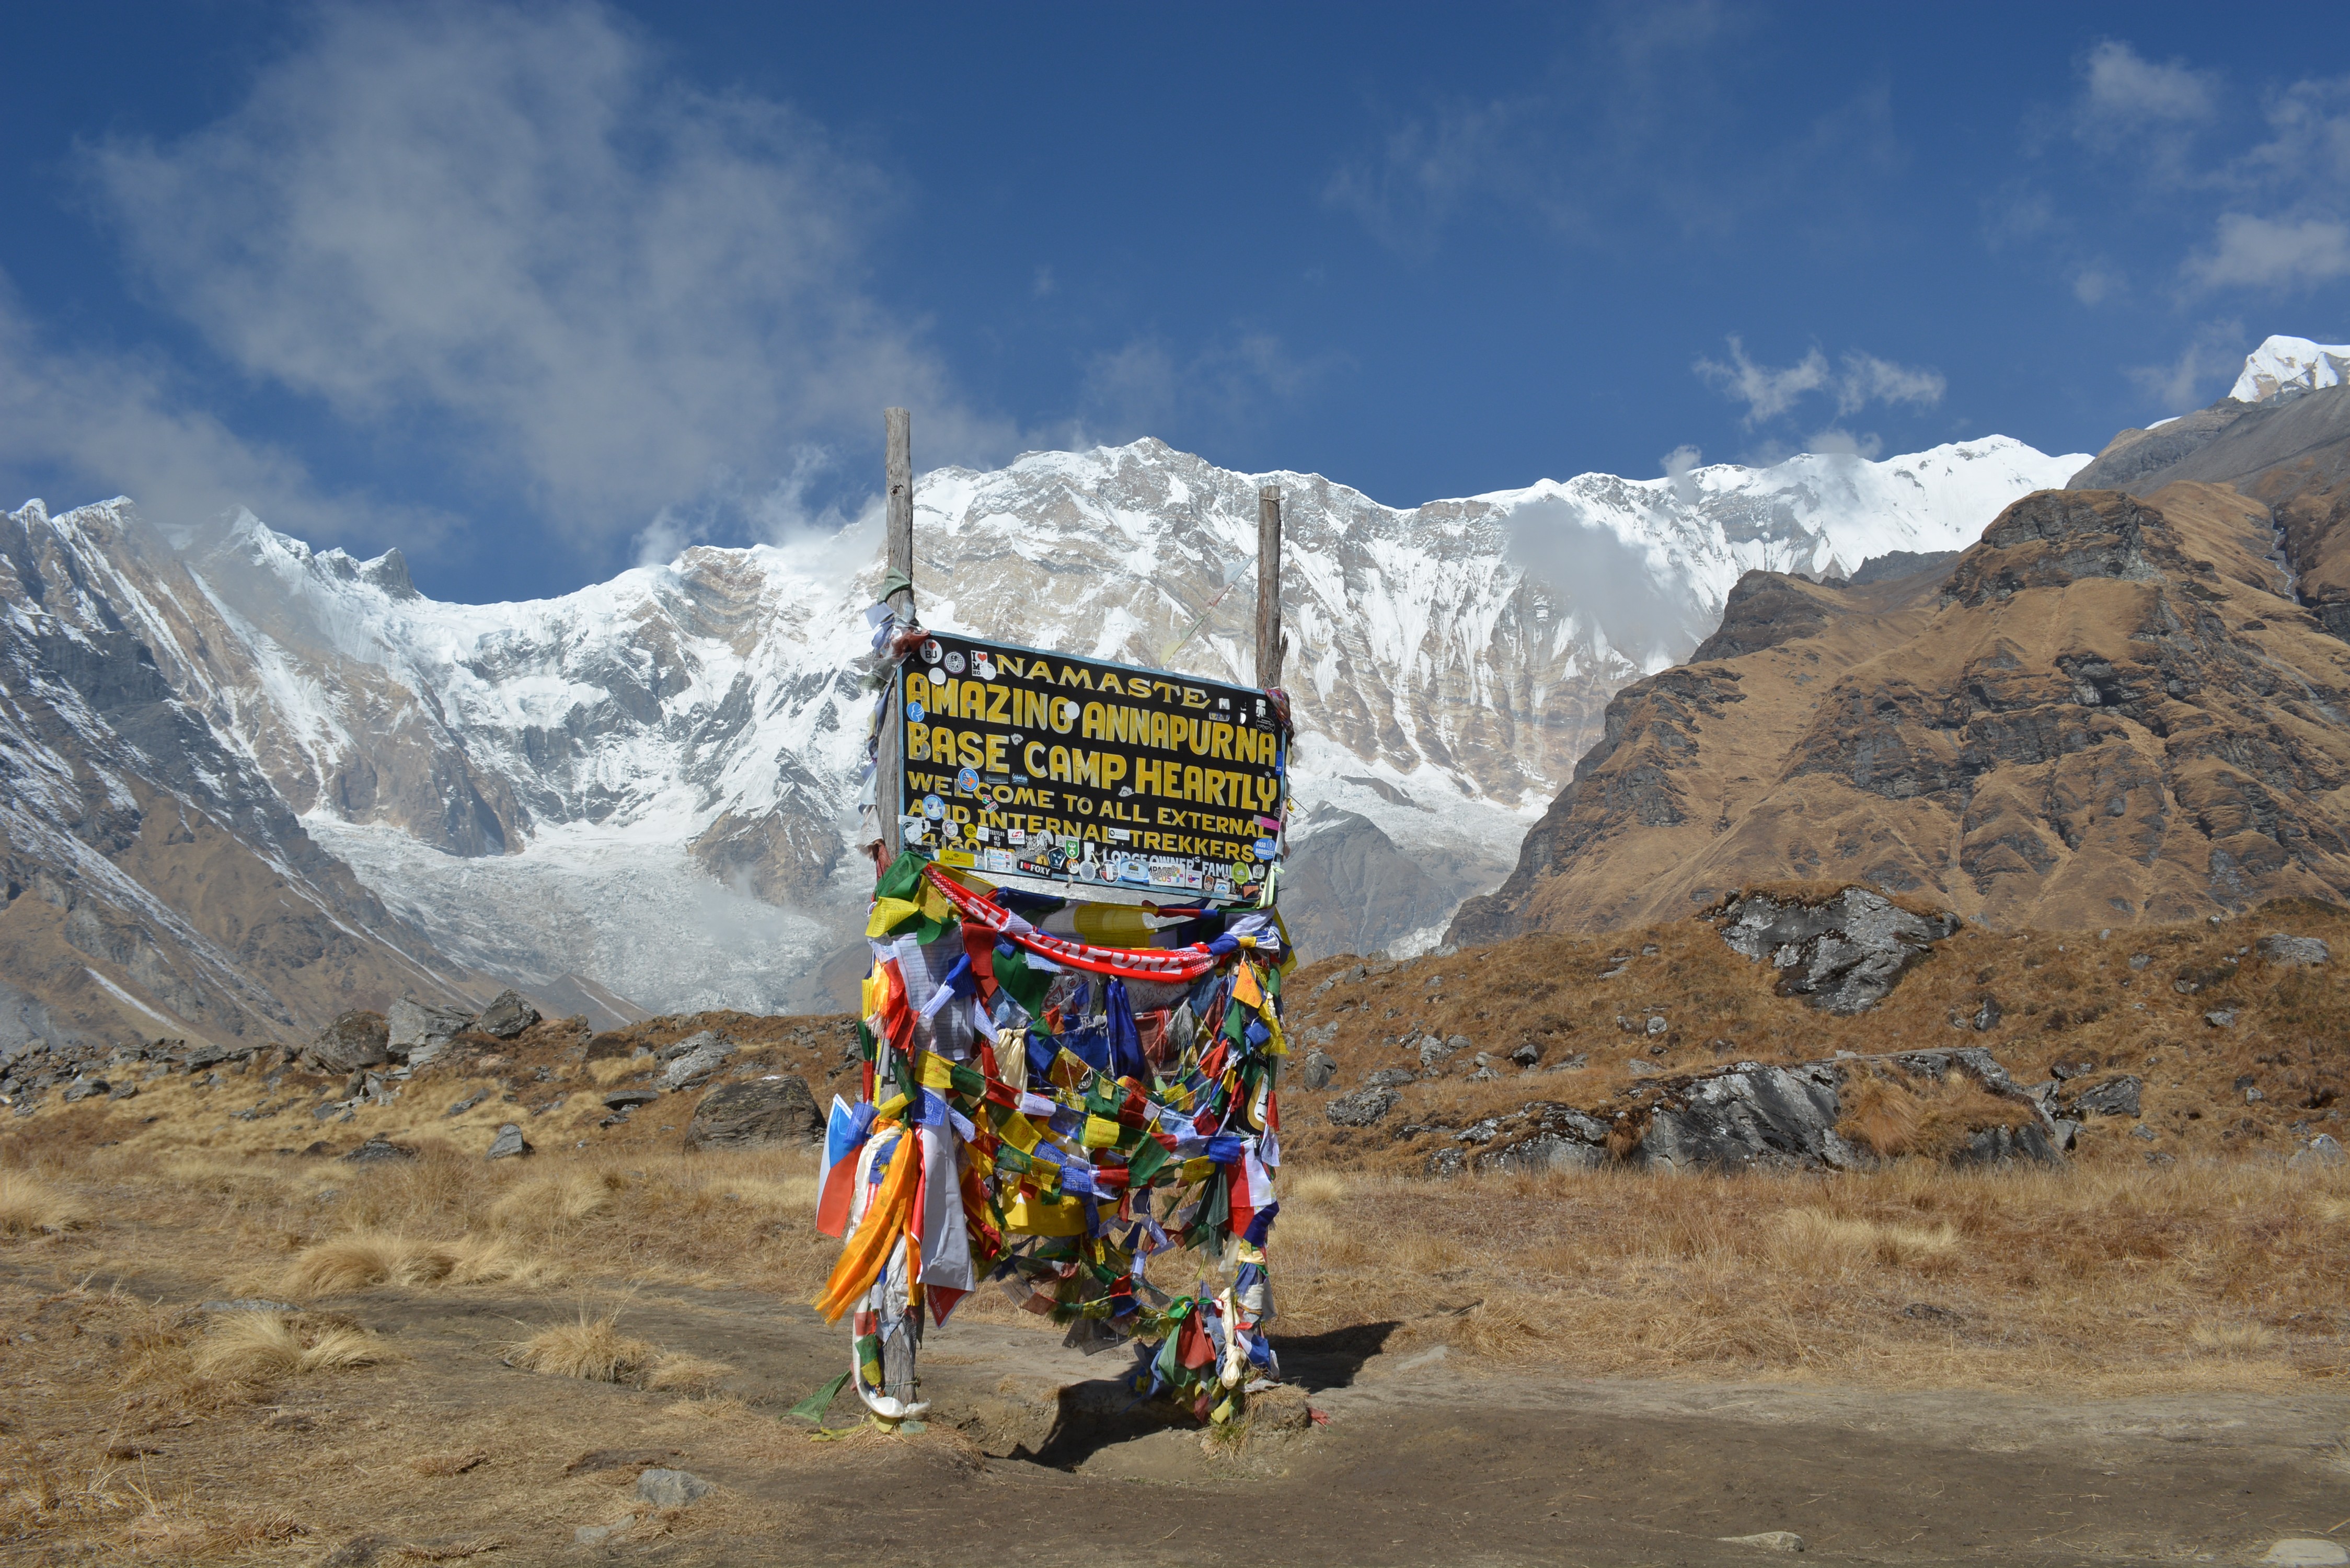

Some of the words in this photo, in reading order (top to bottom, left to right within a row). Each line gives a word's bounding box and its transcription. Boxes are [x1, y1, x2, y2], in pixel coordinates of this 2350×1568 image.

[995, 654, 1211, 708] NAMASTE
[906, 673, 1073, 734] AMAZING
[1082, 702, 1276, 767] ANNAPURNA
[907, 721, 1010, 774] BASE
[1024, 741, 1127, 790] CAMP
[1134, 757, 1277, 812] HEARTLY
[907, 770, 1054, 809] WELCOME
[1063, 794, 1093, 815] TO
[1098, 800, 1150, 824] ALL
[1157, 807, 1275, 839] EXTERNAL
[977, 809, 1117, 845] INTERNAL
[1128, 829, 1264, 866] TREKKERS
[1030, 864, 1051, 875] FOXY
